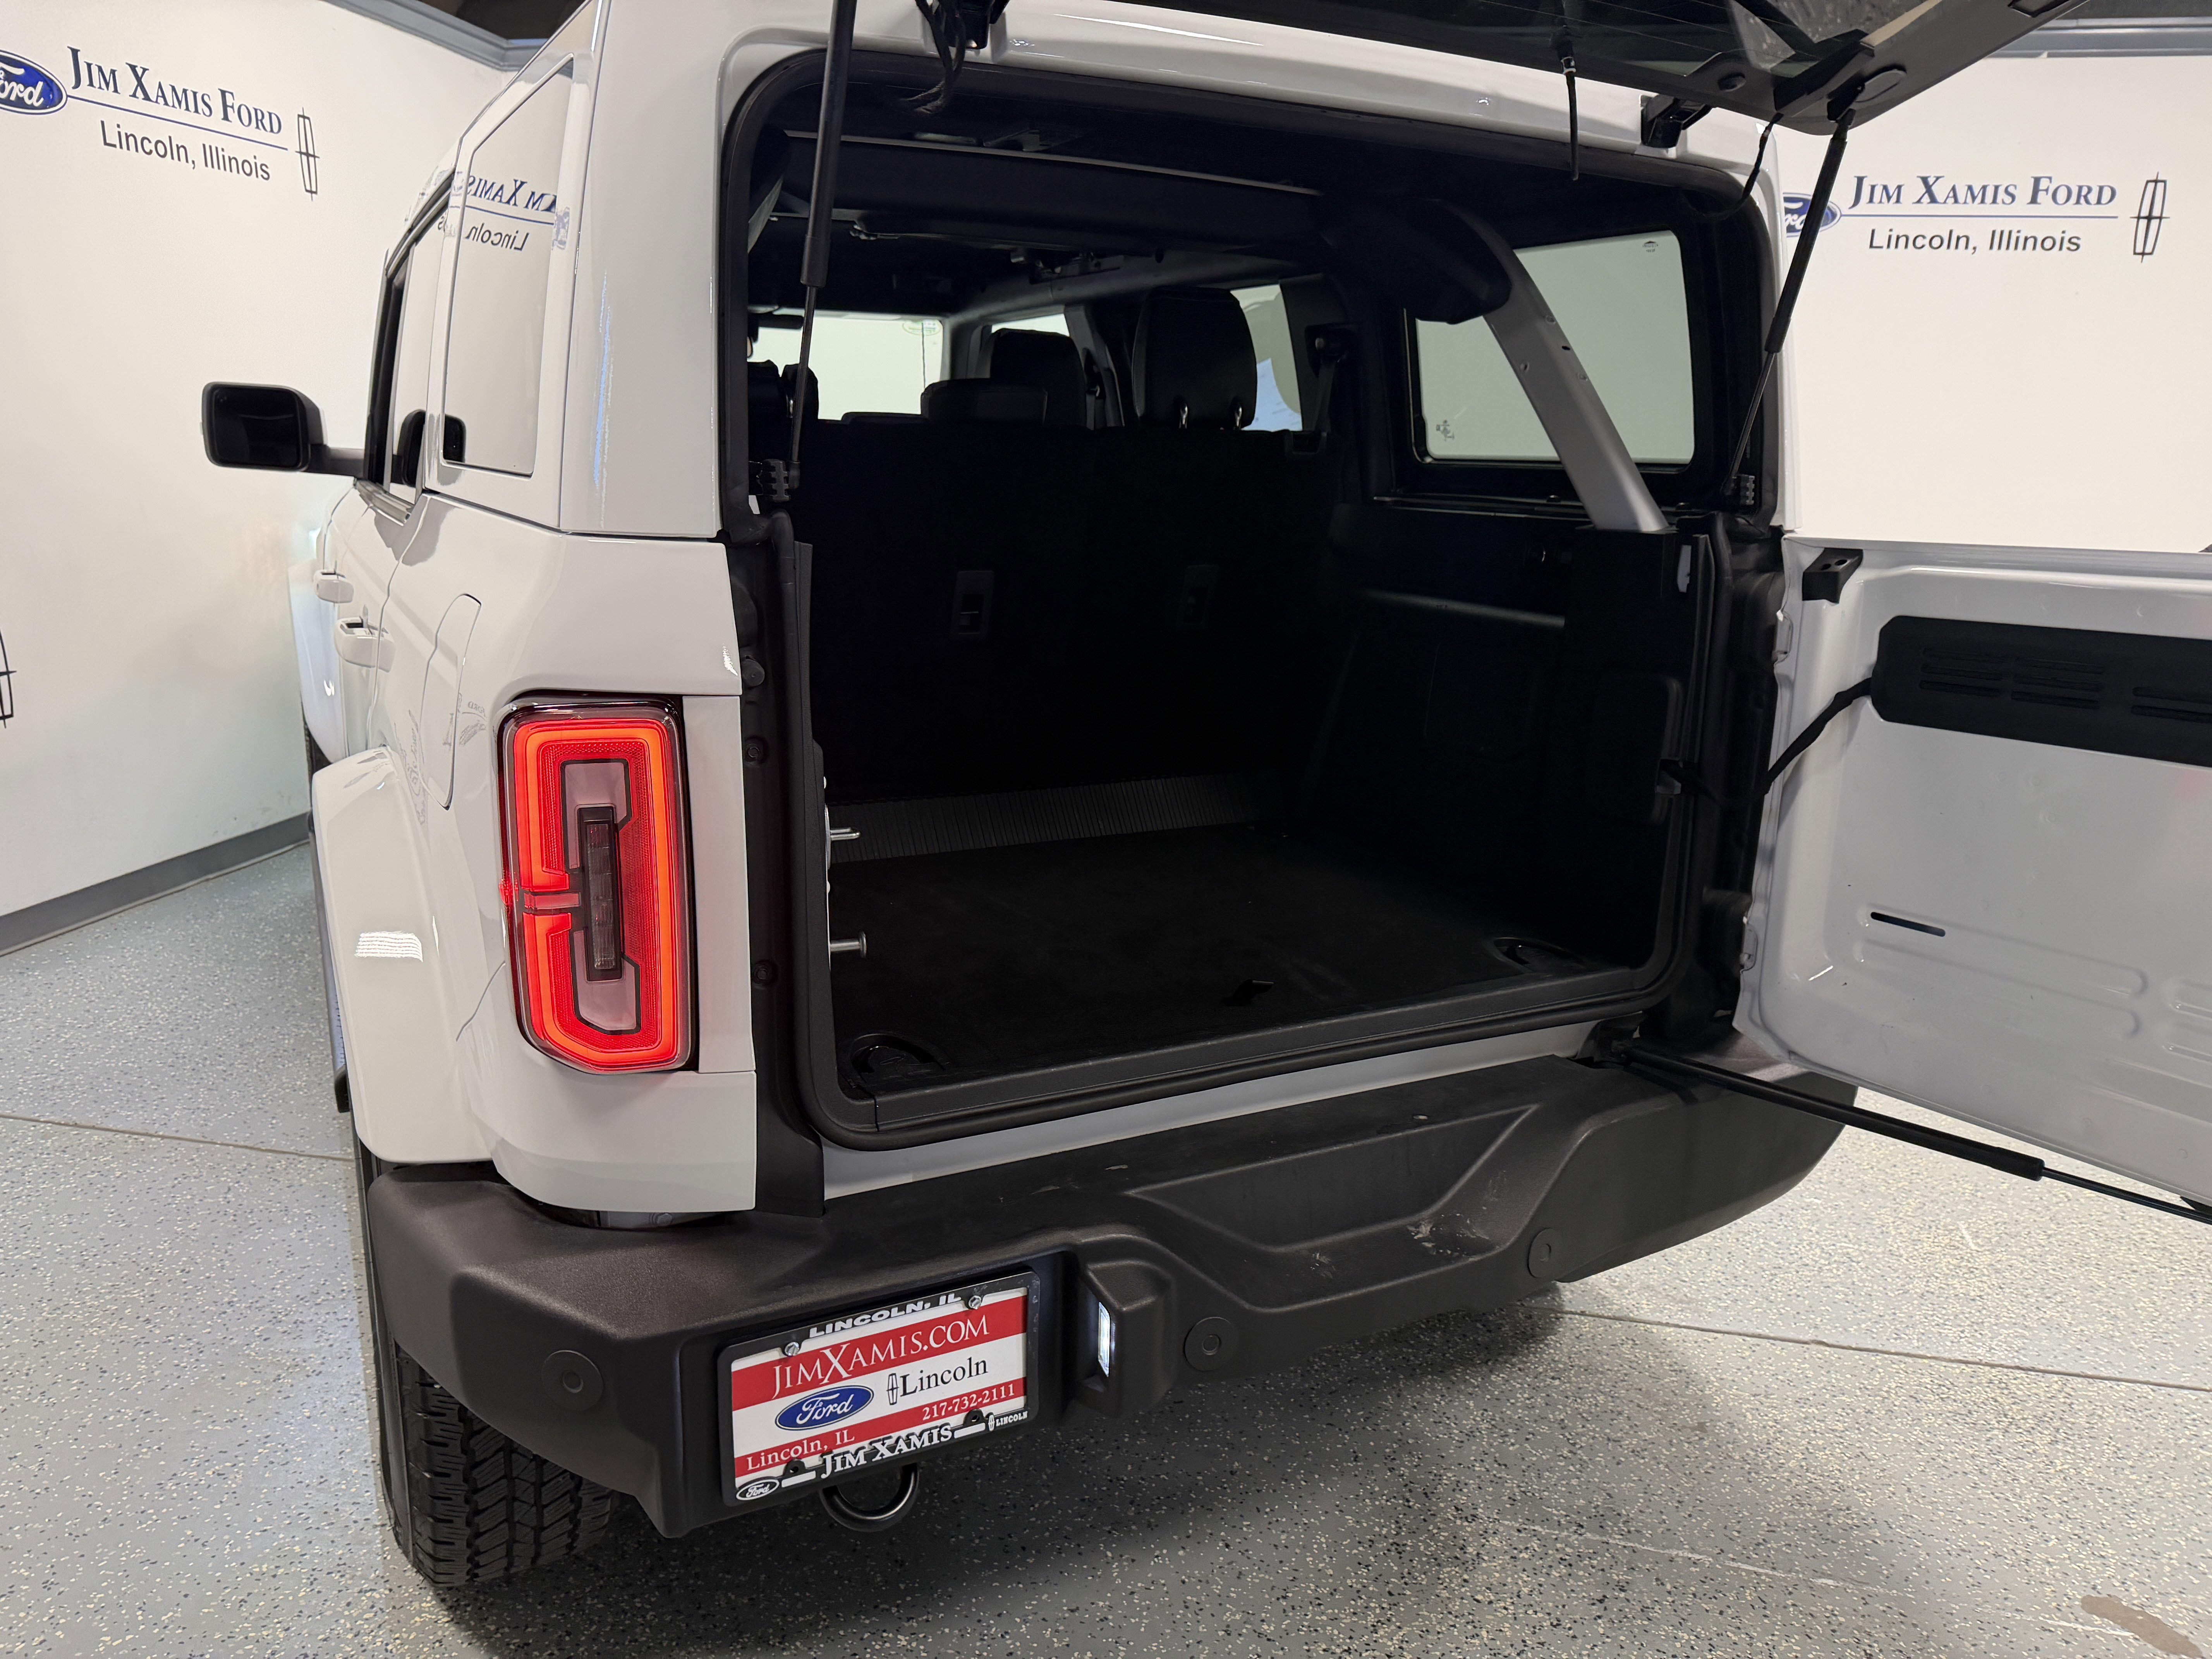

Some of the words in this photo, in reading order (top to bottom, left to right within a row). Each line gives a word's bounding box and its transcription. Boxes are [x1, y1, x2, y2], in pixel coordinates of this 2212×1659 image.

[67, 46, 120, 94] JIM
[125, 62, 213, 118] XAMIS
[218, 88, 282, 134] FORD
[100, 120, 196, 170] Lincoln,
[202, 143, 270, 181] Illinois
[1848, 175, 1905, 209] JIM
[1912, 175, 2017, 206] XAMIS
[2026, 176, 2117, 206] FORD
[1869, 229, 1977, 255] Lincoln,
[1988, 230, 2081, 252] Illinois
[809, 1300, 931, 1338] LINCOLN,
[939, 1293, 962, 1306] IL
[772, 1315, 990, 1399] JIMXAMIS.COM
[900, 1357, 989, 1397] Lincoln
[796, 1394, 854, 1424] Ford
[922, 1383, 1015, 1421] 217-732-2111
[996, 1411, 1028, 1426] LINCOLN
[747, 1441, 829, 1471] Lincoln,
[836, 1430, 855, 1444] IL
[821, 1450, 867, 1479] JIM
[872, 1425, 953, 1461] XAMIS
[746, 1483, 770, 1498] Ford
